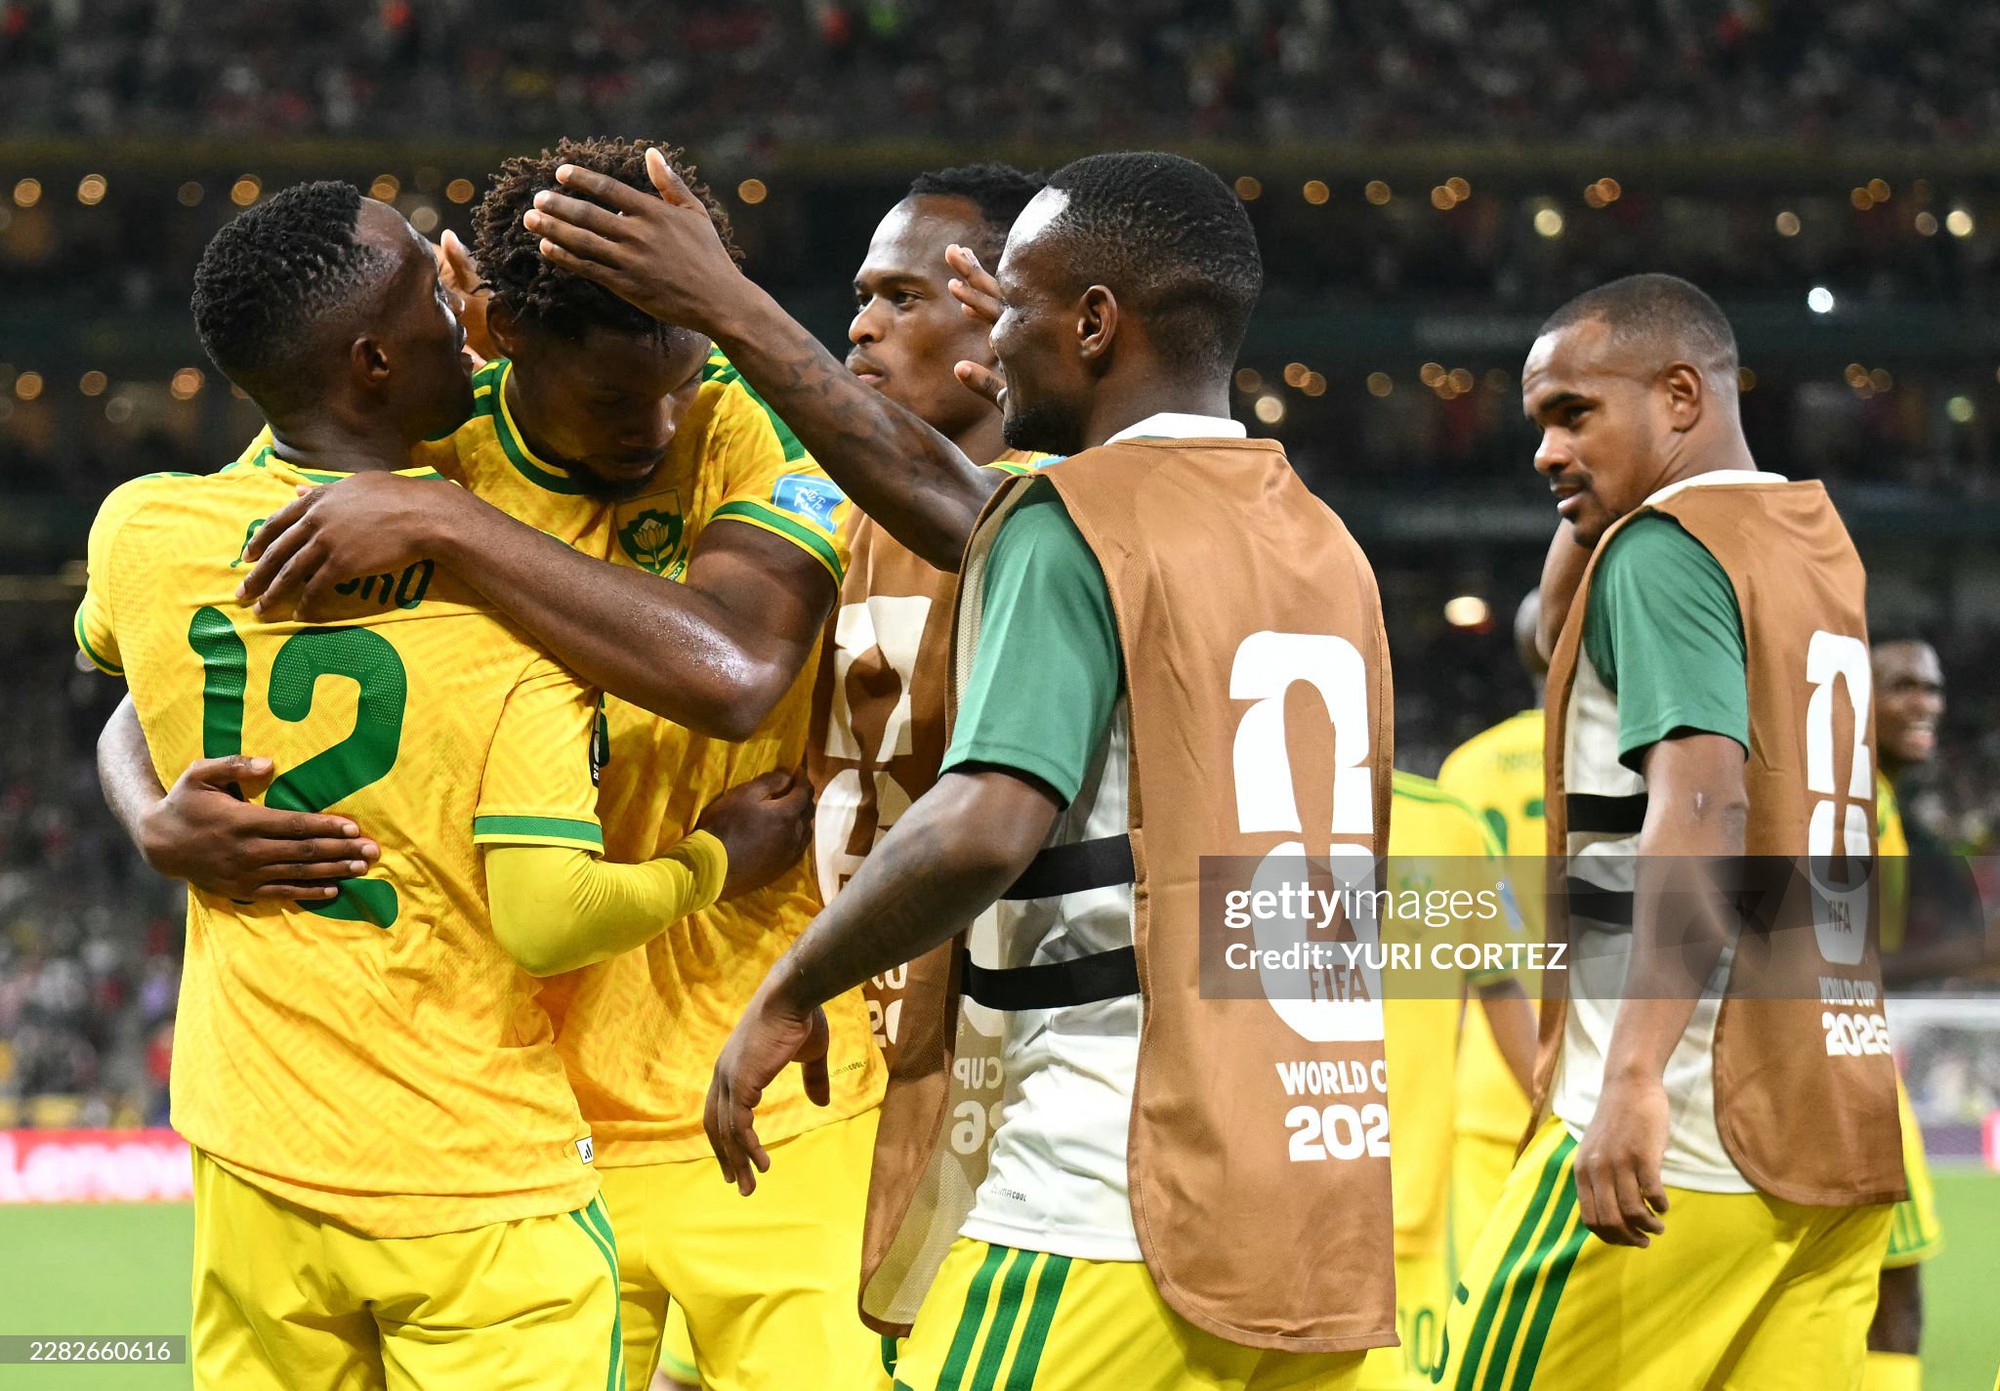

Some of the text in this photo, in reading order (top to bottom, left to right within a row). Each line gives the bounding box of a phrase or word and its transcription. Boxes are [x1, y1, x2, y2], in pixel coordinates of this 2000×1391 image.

[188, 606, 408, 930] 12
[1308, 964, 1371, 1003] FIFA
[1821, 1011, 1892, 1057] 2026
[1275, 1059, 1388, 1095] WORLD C
[1284, 1103, 1391, 1162] 202
